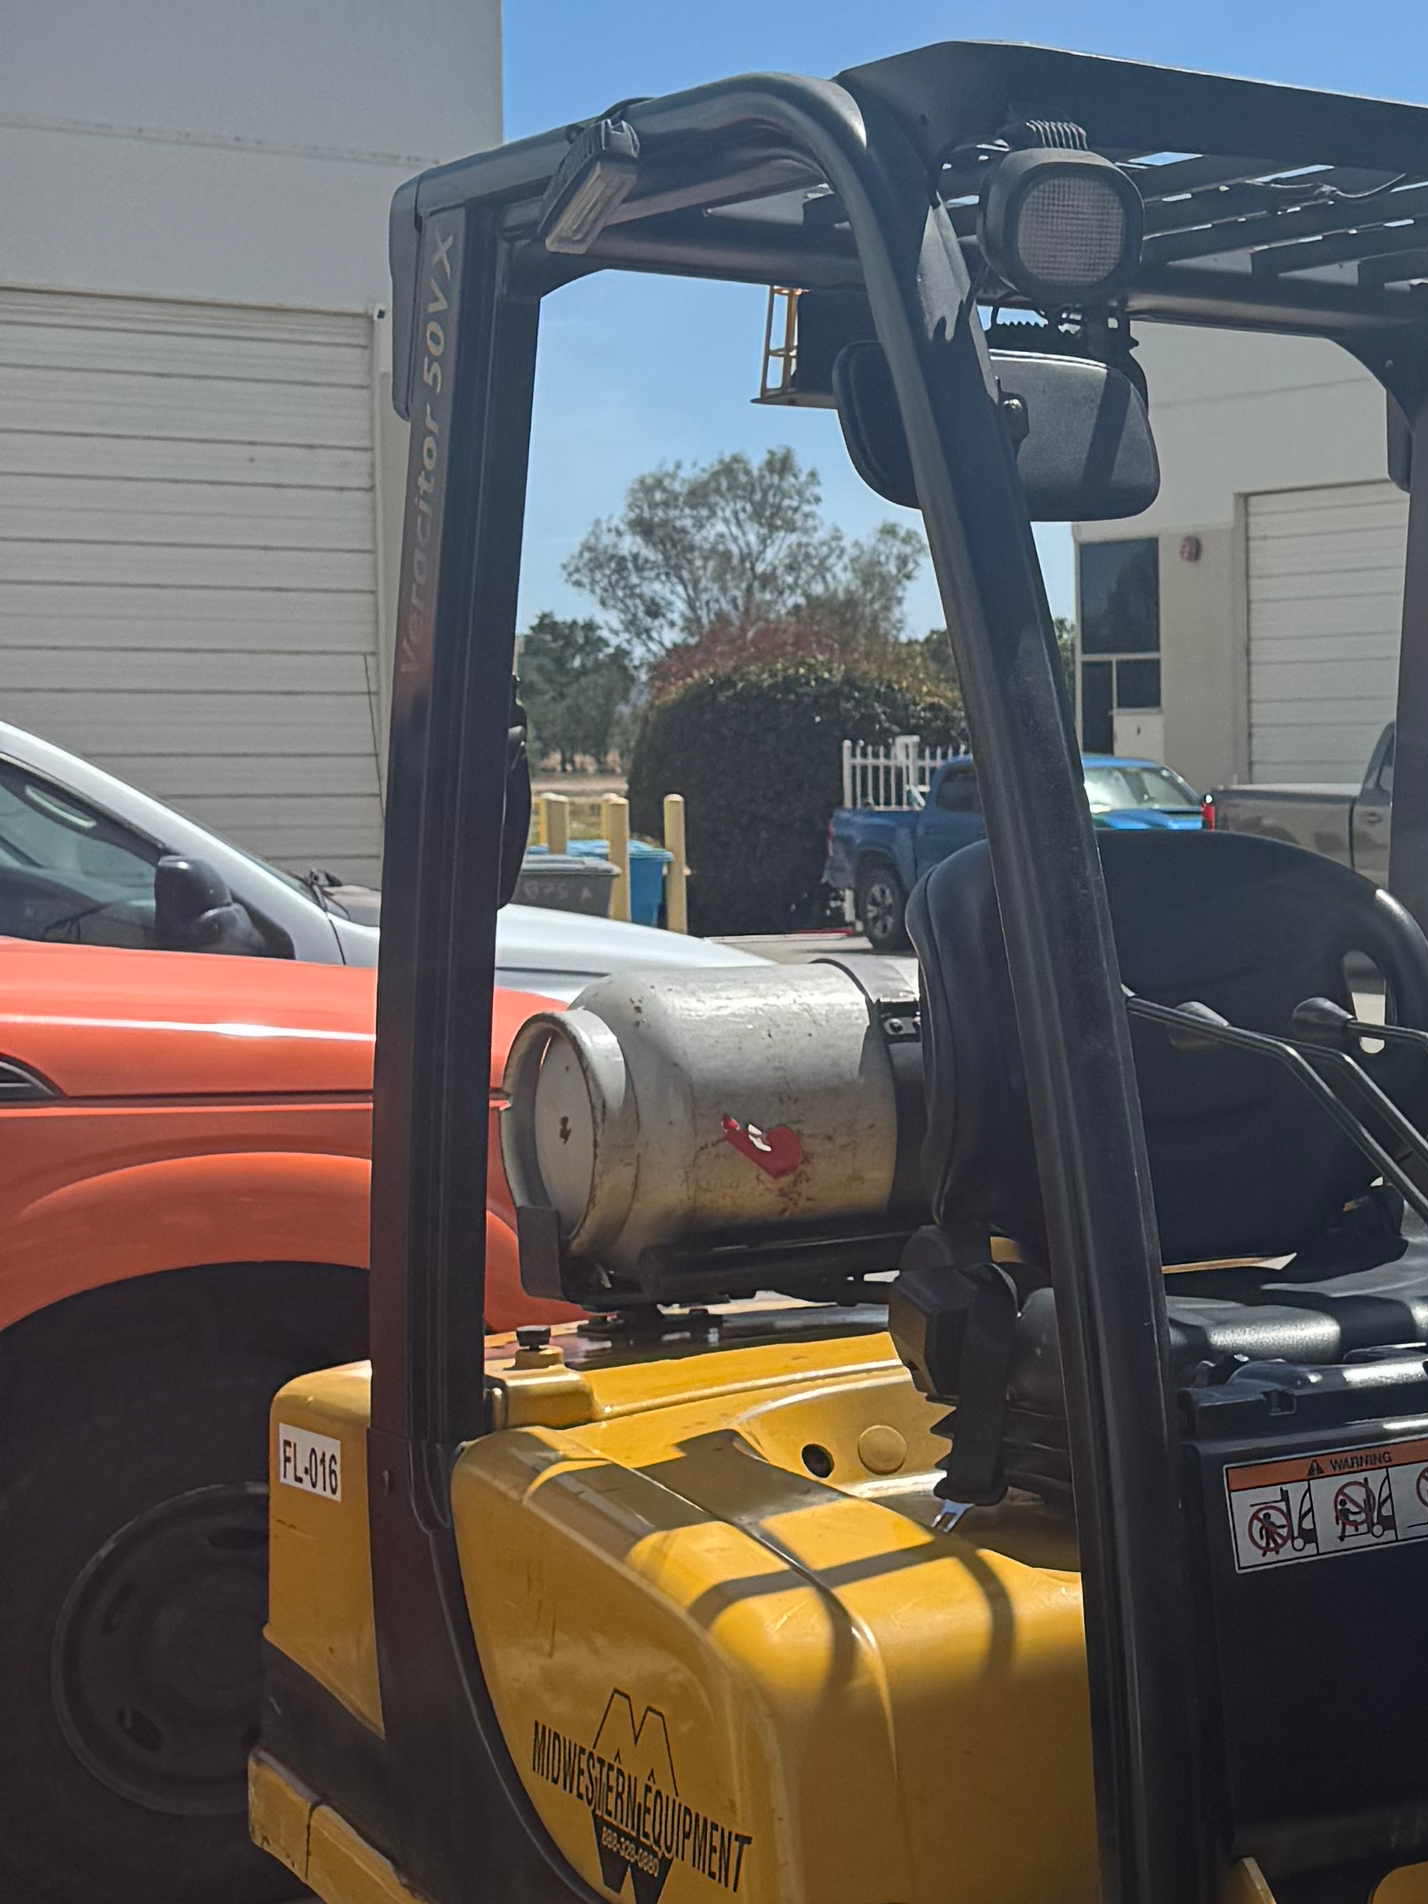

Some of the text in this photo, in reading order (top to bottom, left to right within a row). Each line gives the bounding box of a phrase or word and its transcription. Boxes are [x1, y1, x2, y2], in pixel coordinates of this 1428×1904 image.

[401, 232, 455, 675] Veracitor 50VX
[283, 1439, 339, 1495] FL-016
[1329, 1451, 1393, 1472] WARNING
[532, 1719, 753, 1893] MIDWESTERN EQUIPMENT
